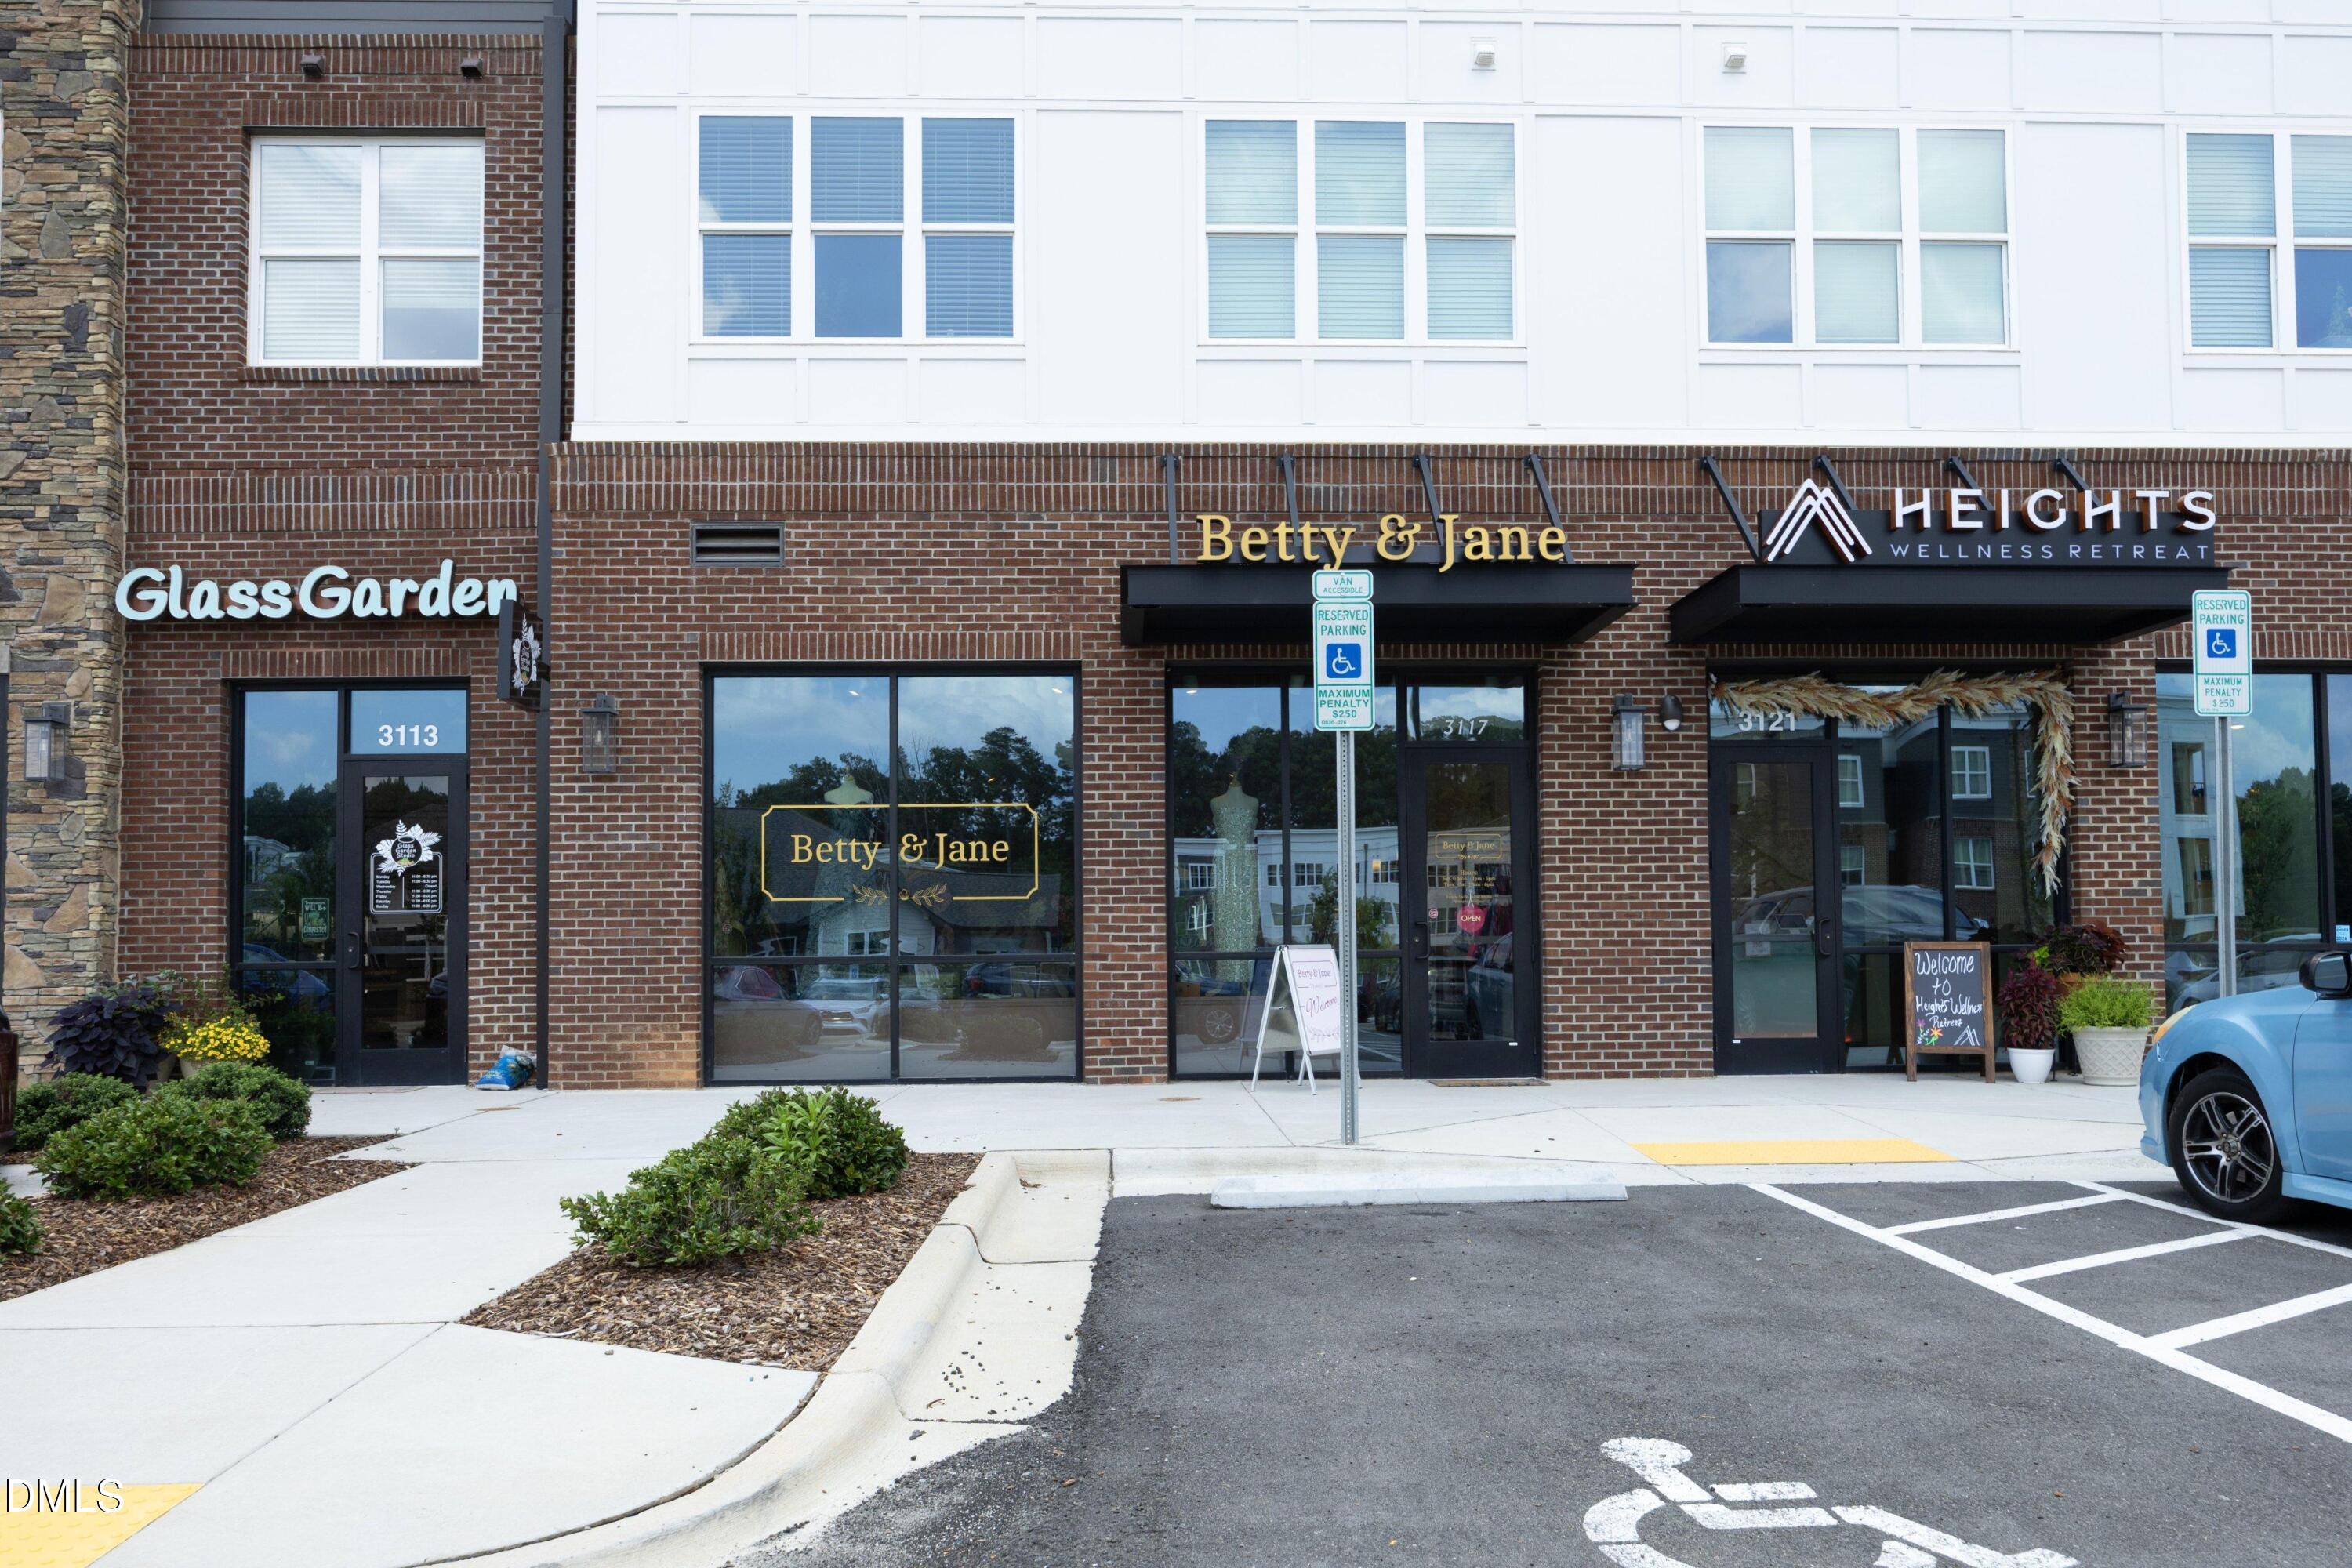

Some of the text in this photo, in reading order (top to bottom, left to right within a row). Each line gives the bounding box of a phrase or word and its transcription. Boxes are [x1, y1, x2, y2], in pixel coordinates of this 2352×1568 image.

[1892, 488, 2217, 532] HEIGHTS
[1196, 514, 1567, 573] Betty & Jane
[1889, 543, 2209, 560] WELLNESS RETREAT
[1333, 577, 1352, 586] VAN
[115, 564, 295, 622] Glass
[2197, 600, 2246, 610] RESERVED
[1318, 610, 1369, 621] RESERVED
[2199, 614, 2245, 625] PARKING
[1320, 625, 1367, 636] PARKING
[1319, 689, 1370, 698] MAXIMUM
[1319, 699, 1370, 708] PENALTY
[1332, 710, 1357, 719] $250
[1738, 710, 1795, 731] 3121
[1443, 720, 1489, 735] 3117
[378, 724, 439, 746] 3113
[790, 833, 1010, 871] Betty & Jane
[1443, 840, 1494, 851] Betty & Jane
[1915, 951, 1975, 975] Welcome
[1298, 968, 1313, 979] Betty
[1319, 968, 1331, 978] Jane
[1305, 996, 1338, 1018] Welcome
[1915, 993, 1983, 1017] Heights Wellness
[1929, 1015, 1963, 1029] Retreat
